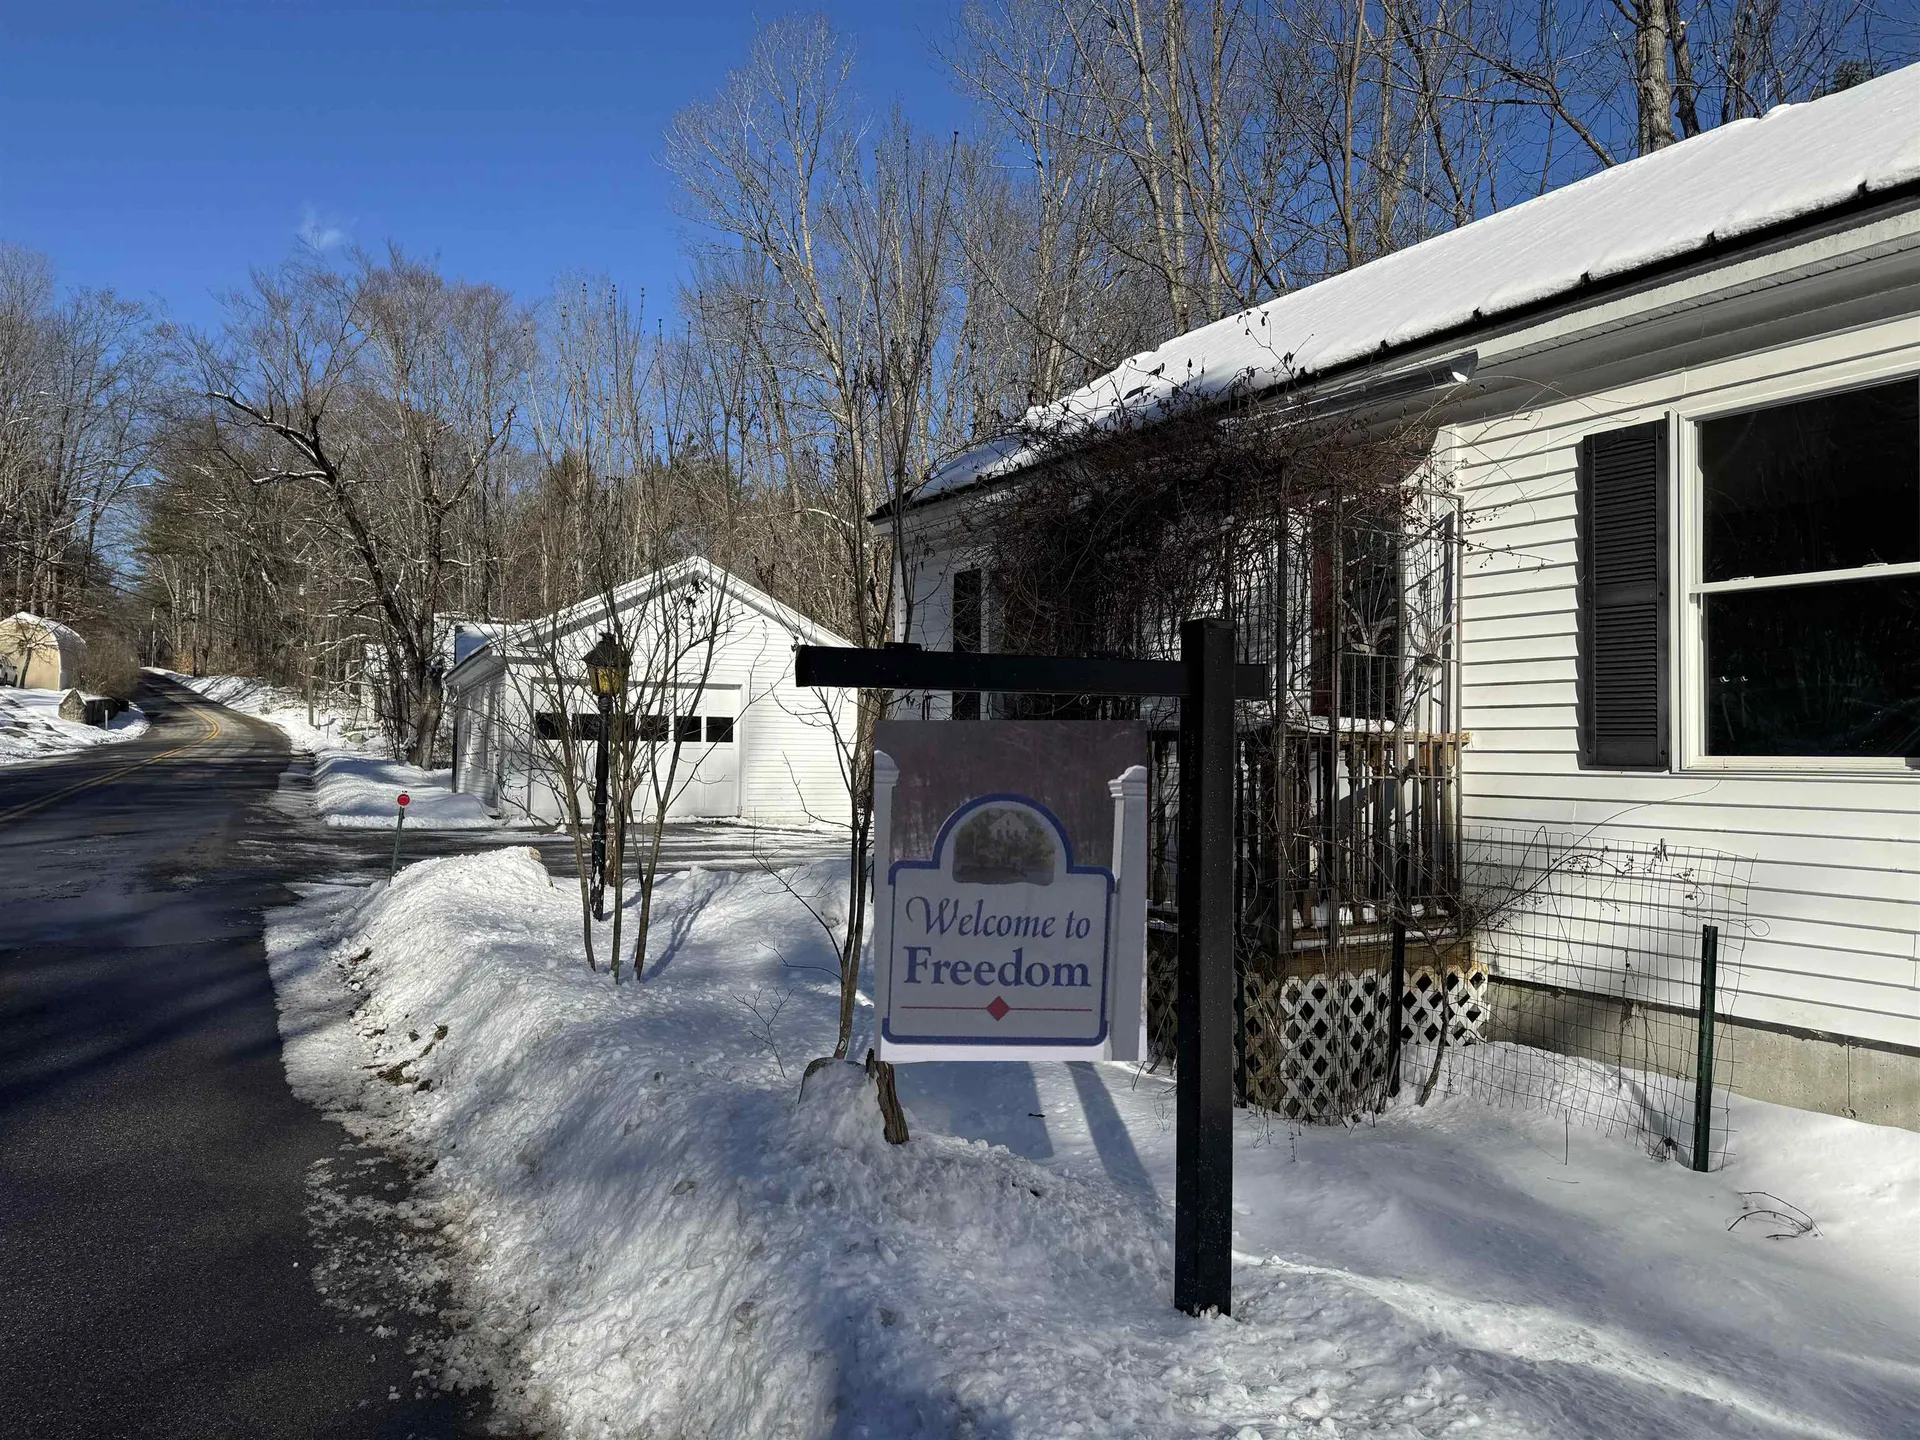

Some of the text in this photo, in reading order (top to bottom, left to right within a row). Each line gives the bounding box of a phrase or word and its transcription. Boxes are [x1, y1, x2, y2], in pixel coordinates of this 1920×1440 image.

[905, 895, 1091, 939] Welcome to
[903, 946, 1091, 988] Freedom
